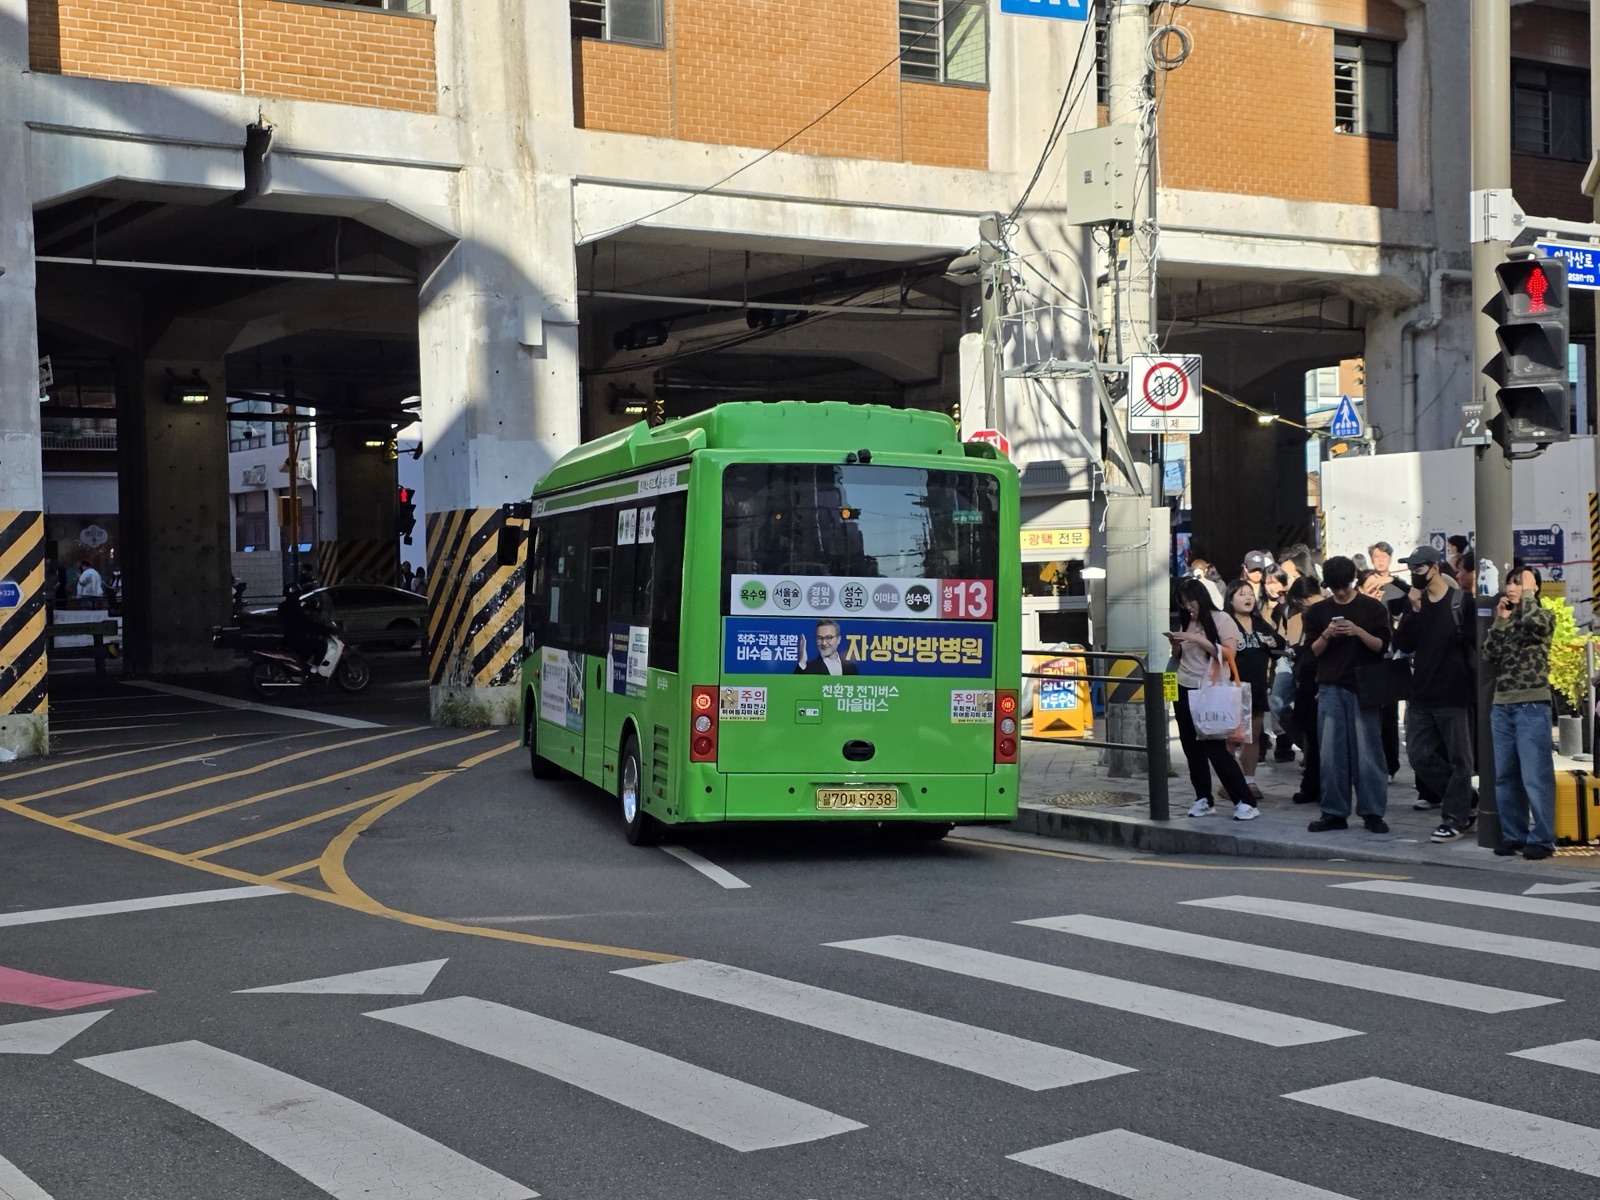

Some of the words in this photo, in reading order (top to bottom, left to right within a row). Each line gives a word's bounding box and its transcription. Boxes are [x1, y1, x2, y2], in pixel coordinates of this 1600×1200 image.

[1567, 272, 1595, 283] asan-ro
[1154, 375, 1178, 396] 30
[1059, 532, 1083, 545] 전문
[1520, 534, 1537, 546] 공사
[1538, 534, 1556, 546] 안내
[3, 589, 15, 597] 328
[740, 589, 767, 600] 옥수역
[774, 586, 800, 597] 서울숲
[811, 586, 830, 597] 경일
[844, 585, 863, 597] 성수
[782, 598, 791, 608] 역
[811, 597, 831, 607] 중고
[844, 597, 863, 608] 공고
[873, 593, 899, 604] 이마트
[905, 592, 931, 606] 성수역
[954, 581, 988, 617] 13
[737, 633, 778, 647] 척추·관절
[780, 634, 799, 647] 질환
[737, 646, 773, 661] 비수술
[774, 647, 799, 662] 치료
[845, 633, 983, 665] 자생한방병원
[741, 690, 765, 703] 주의
[821, 683, 854, 698] 친환경
[856, 684, 899, 698] 전기버스
[953, 693, 976, 705] 주의
[1041, 692, 1075, 709] 구두수선
[836, 698, 889, 713] 마을버스
[859, 792, 892, 806] 5938
